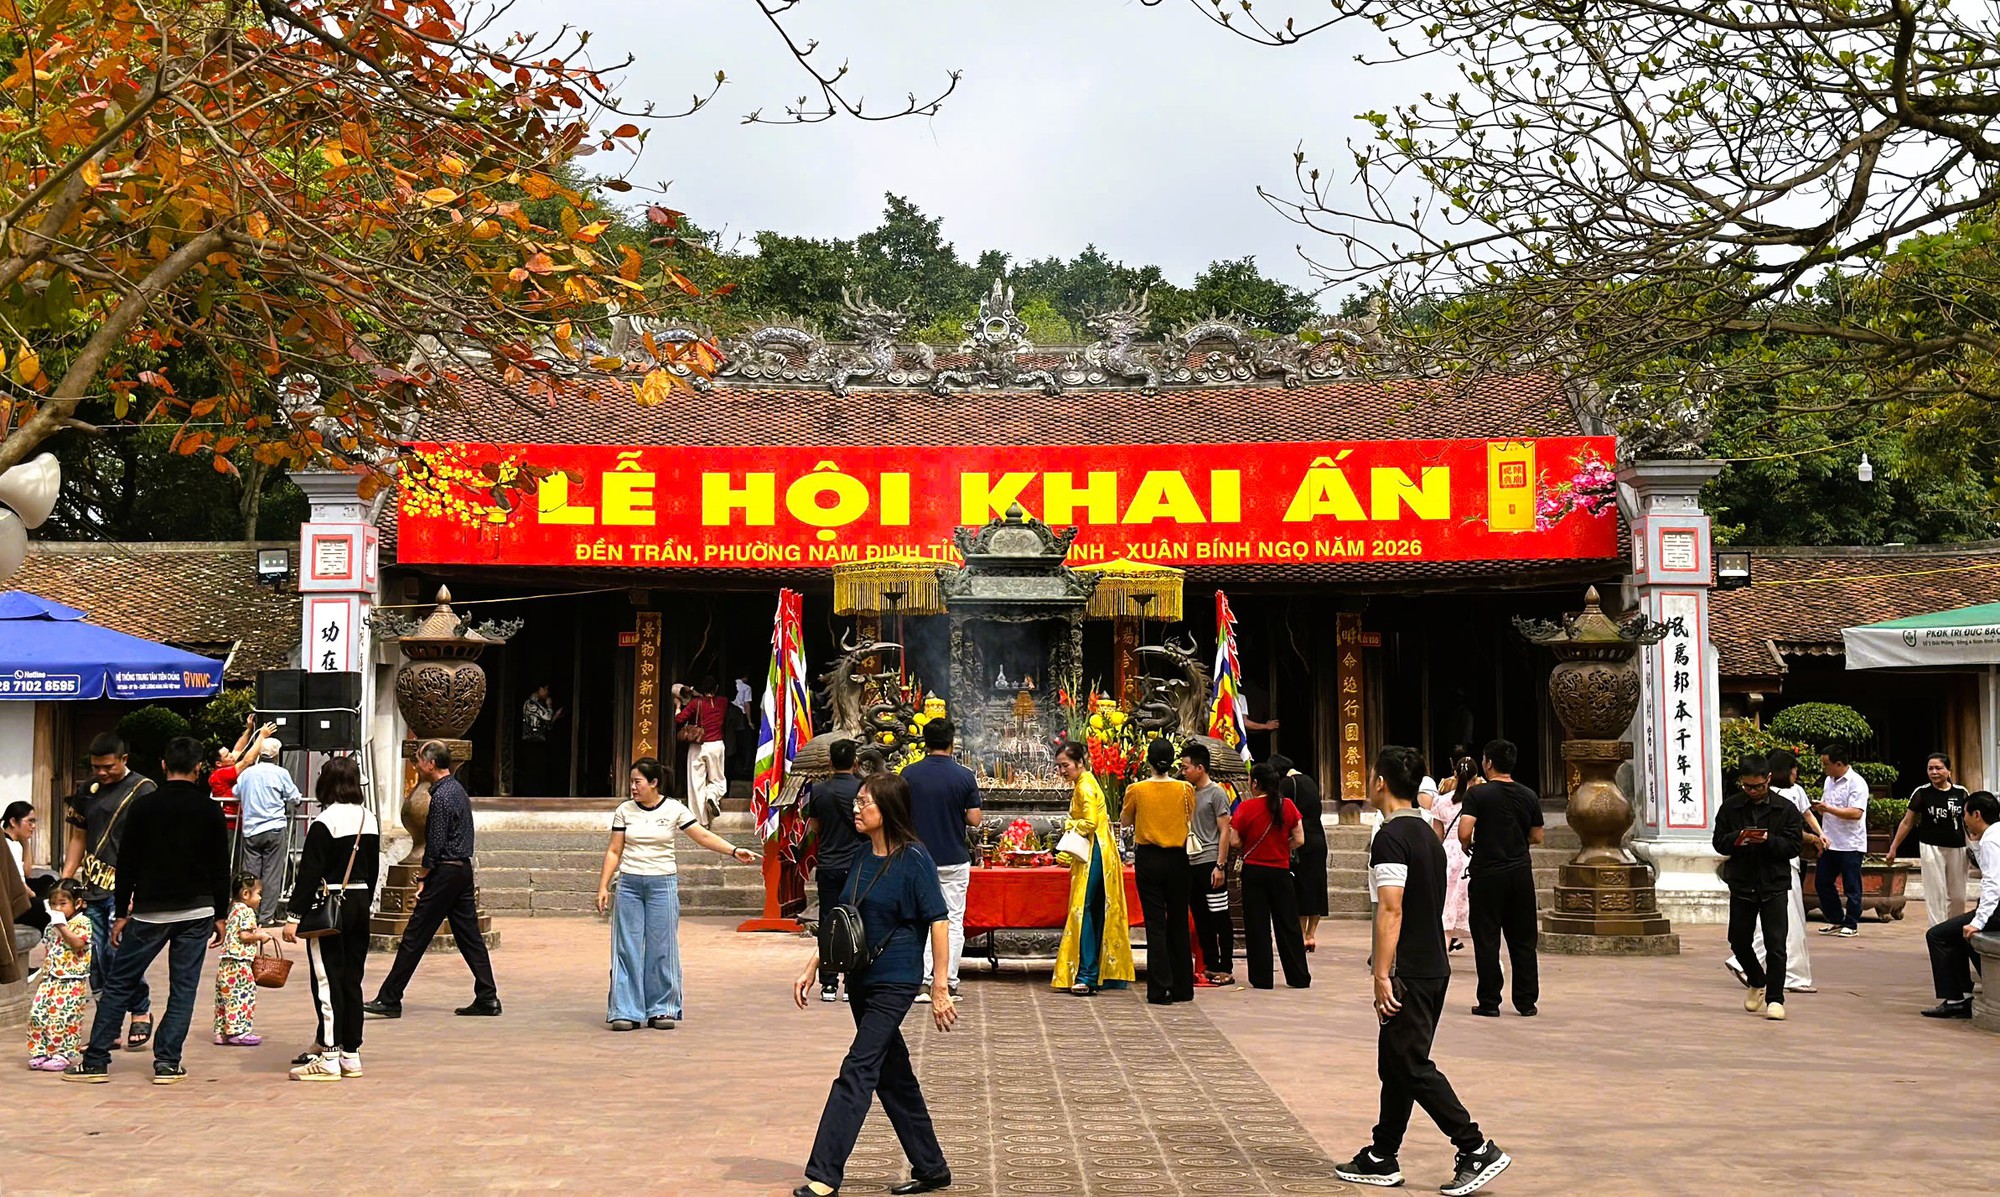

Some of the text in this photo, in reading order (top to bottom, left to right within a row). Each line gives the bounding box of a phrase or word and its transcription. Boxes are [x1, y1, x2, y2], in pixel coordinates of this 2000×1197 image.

[538, 449, 1450, 541] LỄ HỘI KHAI ẤN
[576, 537, 623, 561] ĐỀN
[630, 537, 699, 564] TRẦN,
[704, 540, 800, 561] PHƯỜNG
[809, 544, 857, 561] NAM
[927, 537, 965, 561] TỈN
[1126, 538, 1188, 559] XUÂN
[1196, 537, 1250, 559] BÍNH
[1258, 540, 1309, 561] NGỌ
[1315, 536, 1365, 557] NĂM
[1372, 539, 1422, 556] 2026
[0, 681, 11, 692] 8
[13, 681, 42, 692] 7102
[190, 672, 211, 688] VNVC
